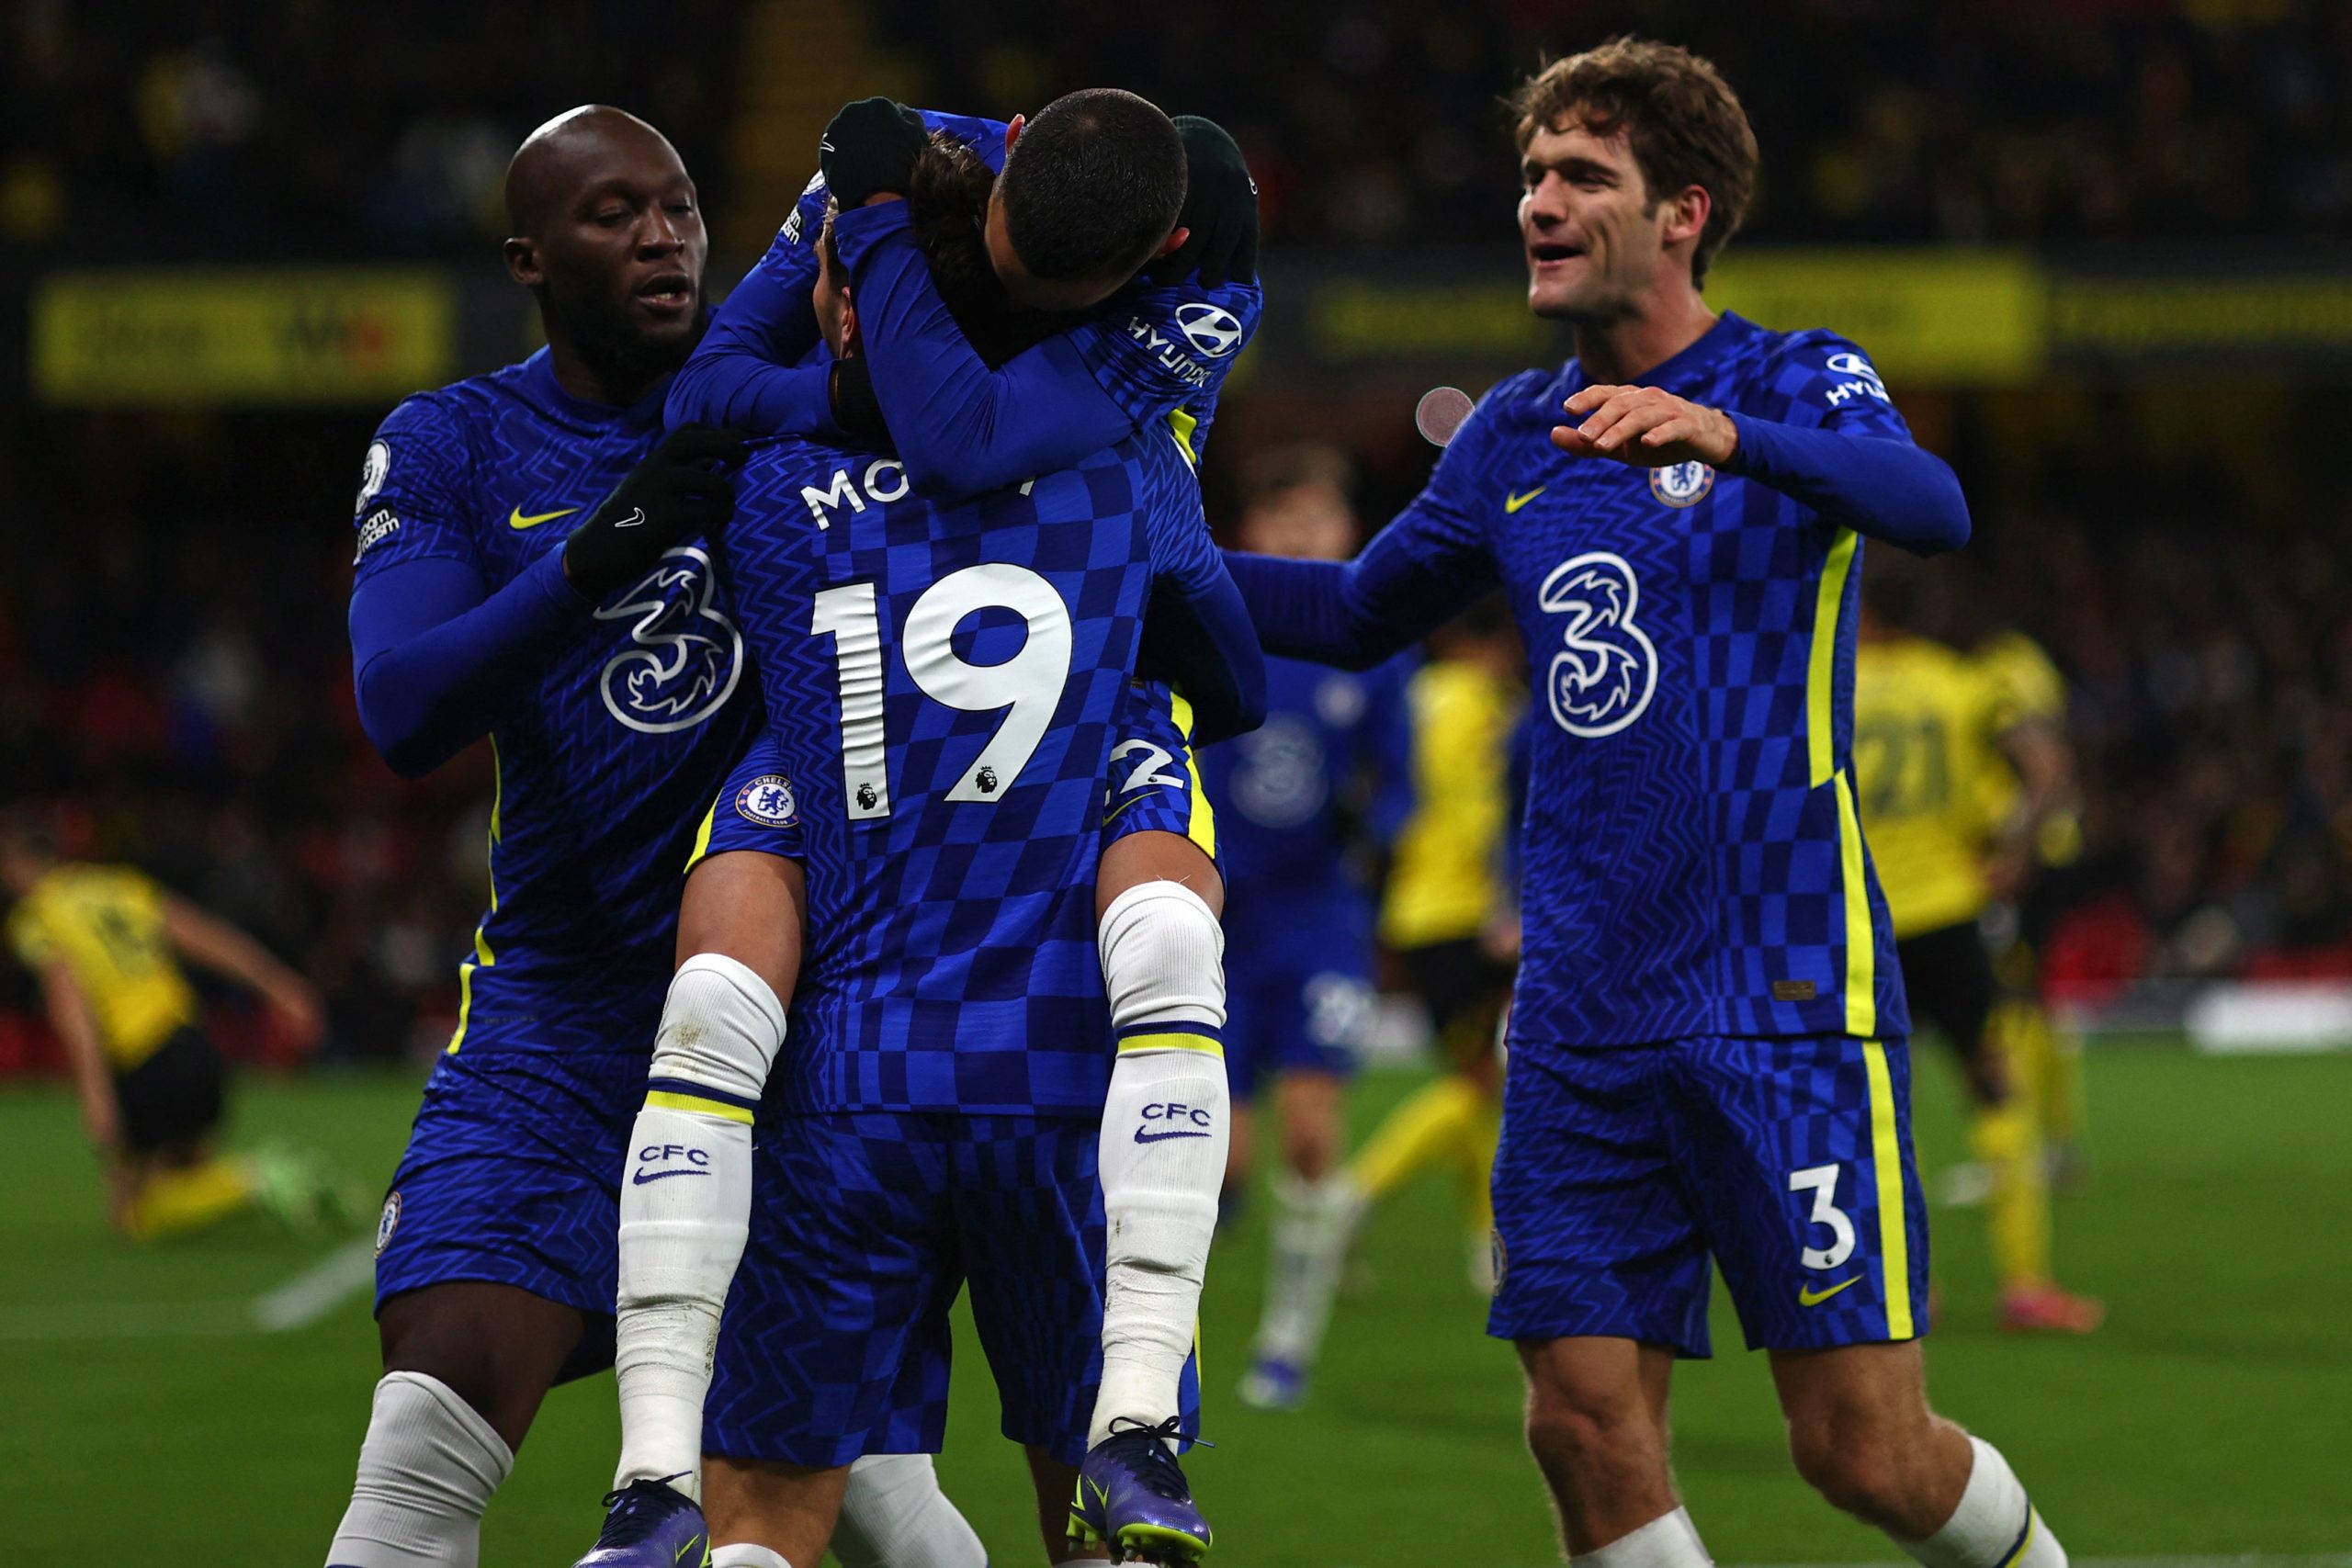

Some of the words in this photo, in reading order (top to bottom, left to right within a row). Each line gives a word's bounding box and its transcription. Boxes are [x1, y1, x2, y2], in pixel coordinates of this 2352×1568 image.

[1127, 317, 1213, 388] HYUNDA
[1539, 551, 1658, 739] 3
[809, 562, 1073, 820] 19
[1104, 739, 1184, 807] 2
[1141, 1102, 1211, 1127] CFC
[639, 1144, 710, 1167] CFC
[1789, 1163, 1857, 1270] 3
